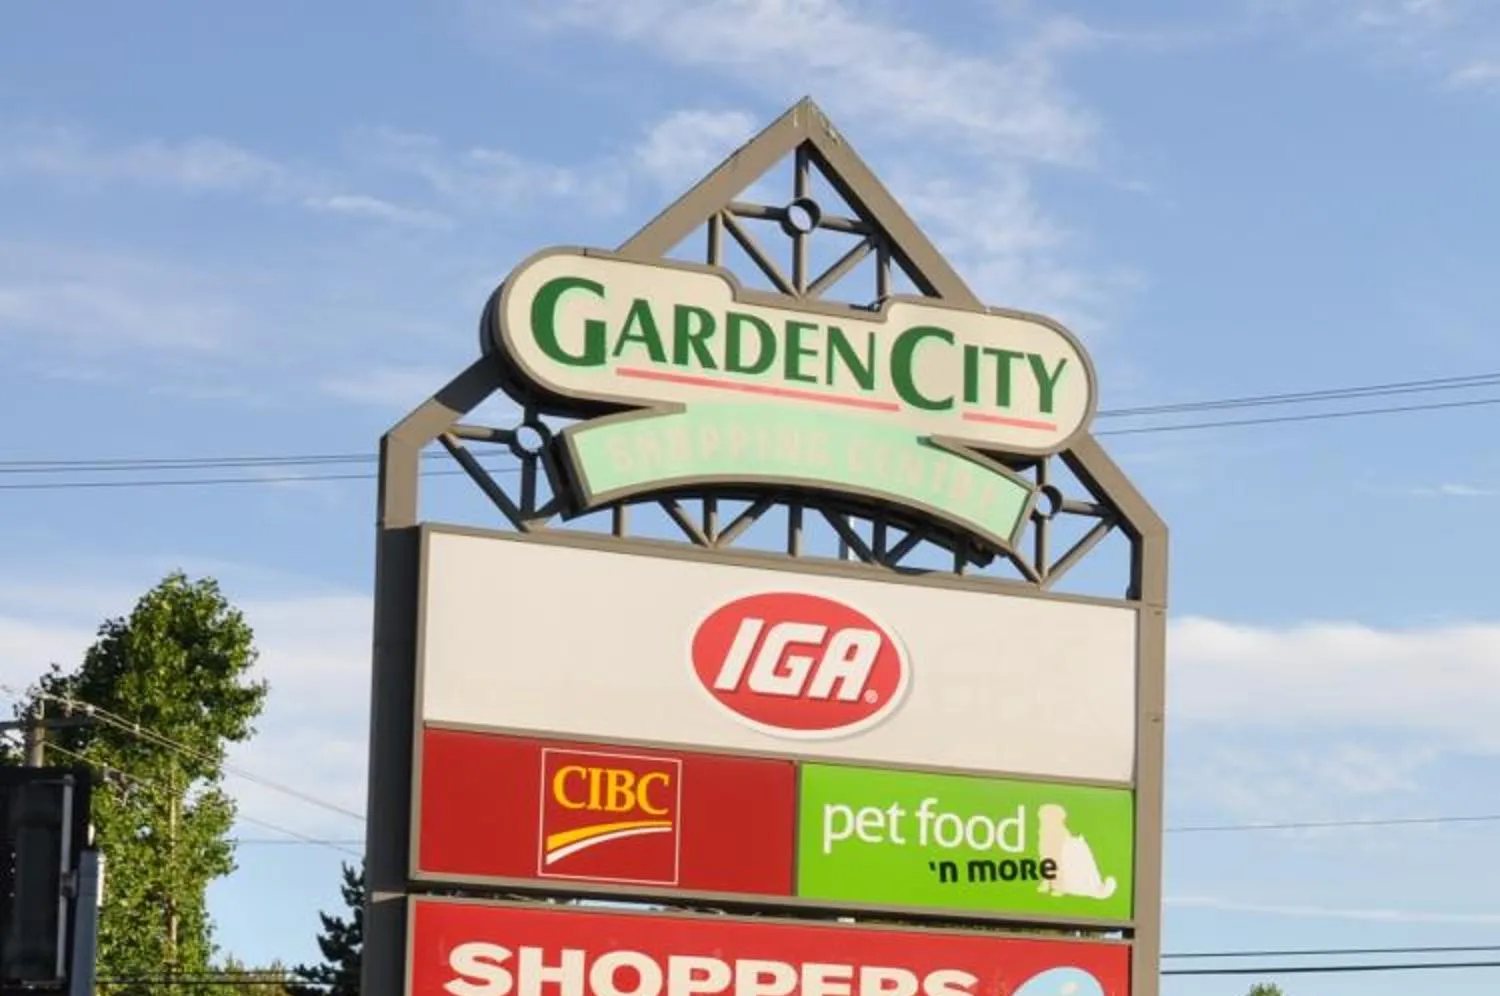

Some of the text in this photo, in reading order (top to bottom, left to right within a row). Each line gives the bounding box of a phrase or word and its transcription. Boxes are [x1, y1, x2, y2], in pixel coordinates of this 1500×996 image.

[714, 617, 882, 701] IGA
[553, 765, 669, 815] CIBC
[823, 798, 1025, 853] pet food
